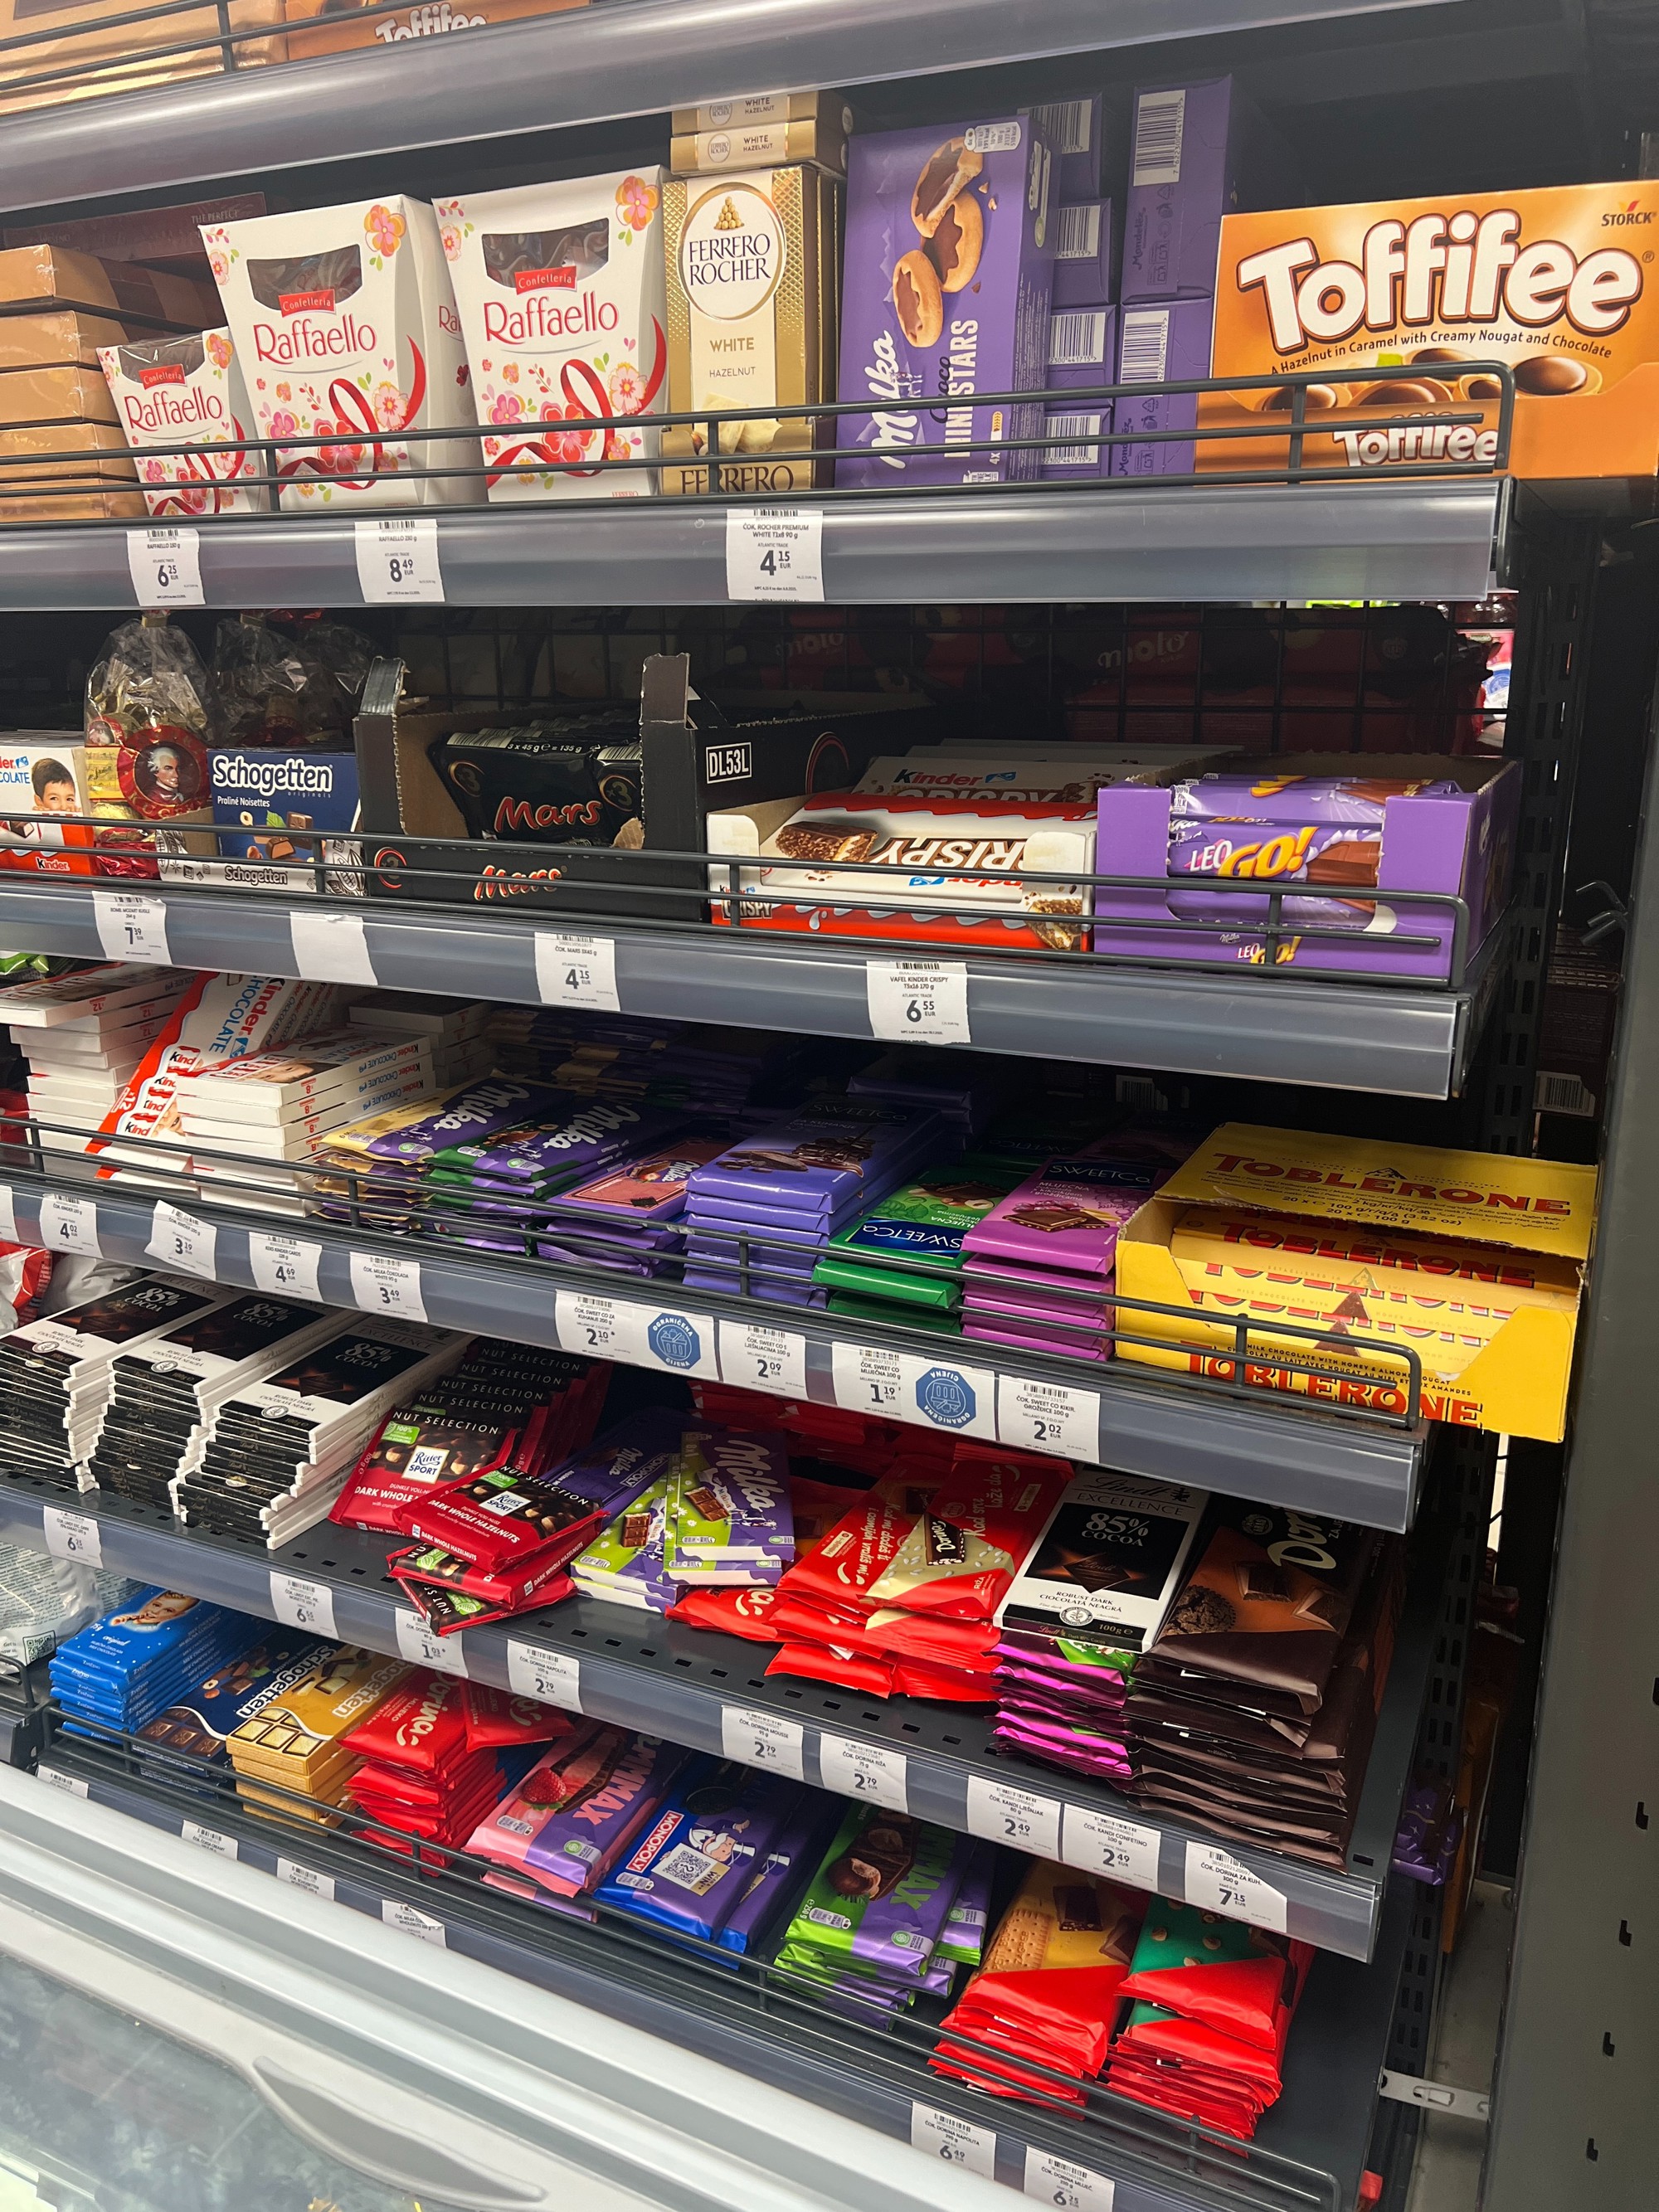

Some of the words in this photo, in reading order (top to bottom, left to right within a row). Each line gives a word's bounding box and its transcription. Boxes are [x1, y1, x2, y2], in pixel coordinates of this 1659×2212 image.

[743, 135, 768, 144] WHITE
[743, 143, 773, 152] HAZELNUT
[1601, 210, 1653, 227] STORCK
[689, 233, 771, 263] FERRERO
[690, 257, 771, 286] ROCHER
[1238, 209, 1643, 355] Toffifee
[484, 292, 619, 344] Raffaello
[253, 314, 377, 363] Raffaello
[709, 337, 755, 352] WHITE
[1280, 348, 1333, 375] Hazelnut
[1335, 345, 1346, 357] in
[1349, 334, 1399, 353] Caramel
[1401, 331, 1428, 345] with
[1430, 329, 1476, 345] Creamy
[1478, 329, 1524, 347] Nougat
[1526, 332, 1550, 345] and
[1552, 333, 1613, 360] Chocolate
[709, 367, 756, 378] HAZELNUT
[124, 387, 223, 430] Raffaello
[390, 558, 402, 582] 8
[402, 559, 413, 568] 49
[760, 550, 776, 576] 4
[779, 551, 790, 562] 15
[158, 565, 169, 587] 6
[168, 565, 177, 574] 25
[709, 746, 750, 777] DL53L
[212, 755, 333, 797] Schogetten
[240, 797, 270, 807] Noisettes
[494, 795, 603, 833] Mars
[1190, 841, 1233, 873] LEO
[1218, 827, 1320, 877] GO!
[224, 867, 289, 886] Schogetten
[474, 863, 562, 901] Mars
[124, 926, 133, 945] 7
[1238, 943, 1260, 960] LEO
[566, 969, 579, 989] 4
[580, 970, 590, 980] 15
[907, 1000, 922, 1023] 6
[922, 1001, 935, 1010] 55
[433, 1082, 531, 1131] Milka
[542, 1104, 641, 1151] Milka
[661, 1160, 702, 1184] Milka
[1213, 1152, 1571, 1216] TOBLERONE
[60, 1223, 70, 1238] 4
[175, 1237, 183, 1254] 3
[1220, 1222, 1535, 1289] TOBLERONE
[276, 1266, 286, 1282] 4
[286, 1268, 295, 1276] 69
[124, 1296, 163, 1312] COCOA
[379, 1287, 391, 1304] 3
[243, 1302, 293, 1320] 85%
[653, 1317, 693, 1338] OGRANIČENA
[586, 1329, 598, 1346] 2
[599, 1331, 609, 1339] 10
[335, 1355, 378, 1369] COCOA
[343, 1342, 400, 1363] 85%
[510, 1353, 581, 1371] SELECTION
[1247, 1344, 1267, 1352] MILK
[1268, 1346, 1316, 1360] CHOCOLATE
[1319, 1356, 1339, 1366] WITH
[1341, 1361, 1370, 1371] HONEY
[491, 1368, 562, 1386] SELECTION
[757, 1359, 769, 1378] 2
[770, 1362, 781, 1371] 09
[1285, 1357, 1302, 1366] LAIT
[1305, 1360, 1326, 1369] AVEC
[1328, 1364, 1361, 1375] NOUGAT
[1431, 1384, 1472, 1396] AMANDES
[441, 1380, 466, 1389] NUT
[472, 1383, 544, 1400] SELECTION
[870, 1384, 884, 1403] 1
[884, 1386, 895, 1395] 19
[419, 1393, 444, 1405] NUT
[450, 1397, 523, 1414] SELECTION
[1024, 1403, 1053, 1415] GROŽDICE
[1031, 1399, 1048, 1407] SWEET
[393, 1411, 421, 1422] NUT
[425, 1416, 499, 1436] SELECTION
[924, 1404, 971, 1426] OGRANIČENA
[1034, 1421, 1047, 1441] 2
[1048, 1424, 1062, 1434] 02
[415, 1452, 442, 1466] Ritter
[609, 1448, 644, 1475] Milka
[408, 1464, 438, 1475] SPORT
[714, 1440, 785, 1513] Milka
[355, 1486, 379, 1497] DARK
[380, 1490, 415, 1503] WHOLE
[501, 1466, 523, 1477] NUT
[526, 1474, 589, 1505] SELECTION
[486, 1500, 513, 1512] SPORT
[1077, 1494, 1184, 1516] EXCELLENCE
[428, 1500, 448, 1510] DARK
[449, 1505, 476, 1523] WHOLE
[476, 1519, 521, 1544] HAZELNUTS
[1086, 1513, 1151, 1537] 85%
[67, 1537, 76, 1551] 6
[932, 1520, 956, 1553] Dorina
[1081, 1530, 1143, 1547] COCOA
[434, 1536, 450, 1549] WHOLE
[450, 1543, 477, 1561] HAZELNUTS
[1057, 1592, 1089, 1601] ROBUST
[296, 1608, 306, 1623] 6
[1038, 1626, 1060, 1636] Lindt
[1098, 1623, 1122, 1635] 100g
[422, 1644, 433, 1659] 1
[236, 1646, 337, 1719] Schogetten
[535, 1679, 546, 1694] 2
[546, 1682, 554, 1690] 79
[751, 1723, 769, 1733] DORINA
[770, 1728, 789, 1739] MOUSSE
[755, 1741, 766, 1758] 2
[766, 1745, 776, 1754] 79
[854, 1754, 874, 1765] DORINA
[854, 1773, 866, 1791] 2
[867, 1777, 877, 1786] 79
[1002, 1800, 1019, 1809] KANDI
[1005, 1818, 1016, 1836] 2
[1018, 1824, 1030, 1833] 49
[632, 1813, 680, 1870] MONOPOLY
[1097, 1828, 1115, 1838] KANDI
[1115, 1832, 1147, 1847] CONFETINO
[1102, 1849, 1115, 1867] 2
[1117, 1854, 1130, 1863] 49
[1215, 1867, 1238, 1879] DORINA
[1219, 1888, 1233, 1905] 7
[1233, 1893, 1246, 1903] 15
[939, 2145, 952, 2161] 6
[1053, 2190, 1067, 2206] 6
